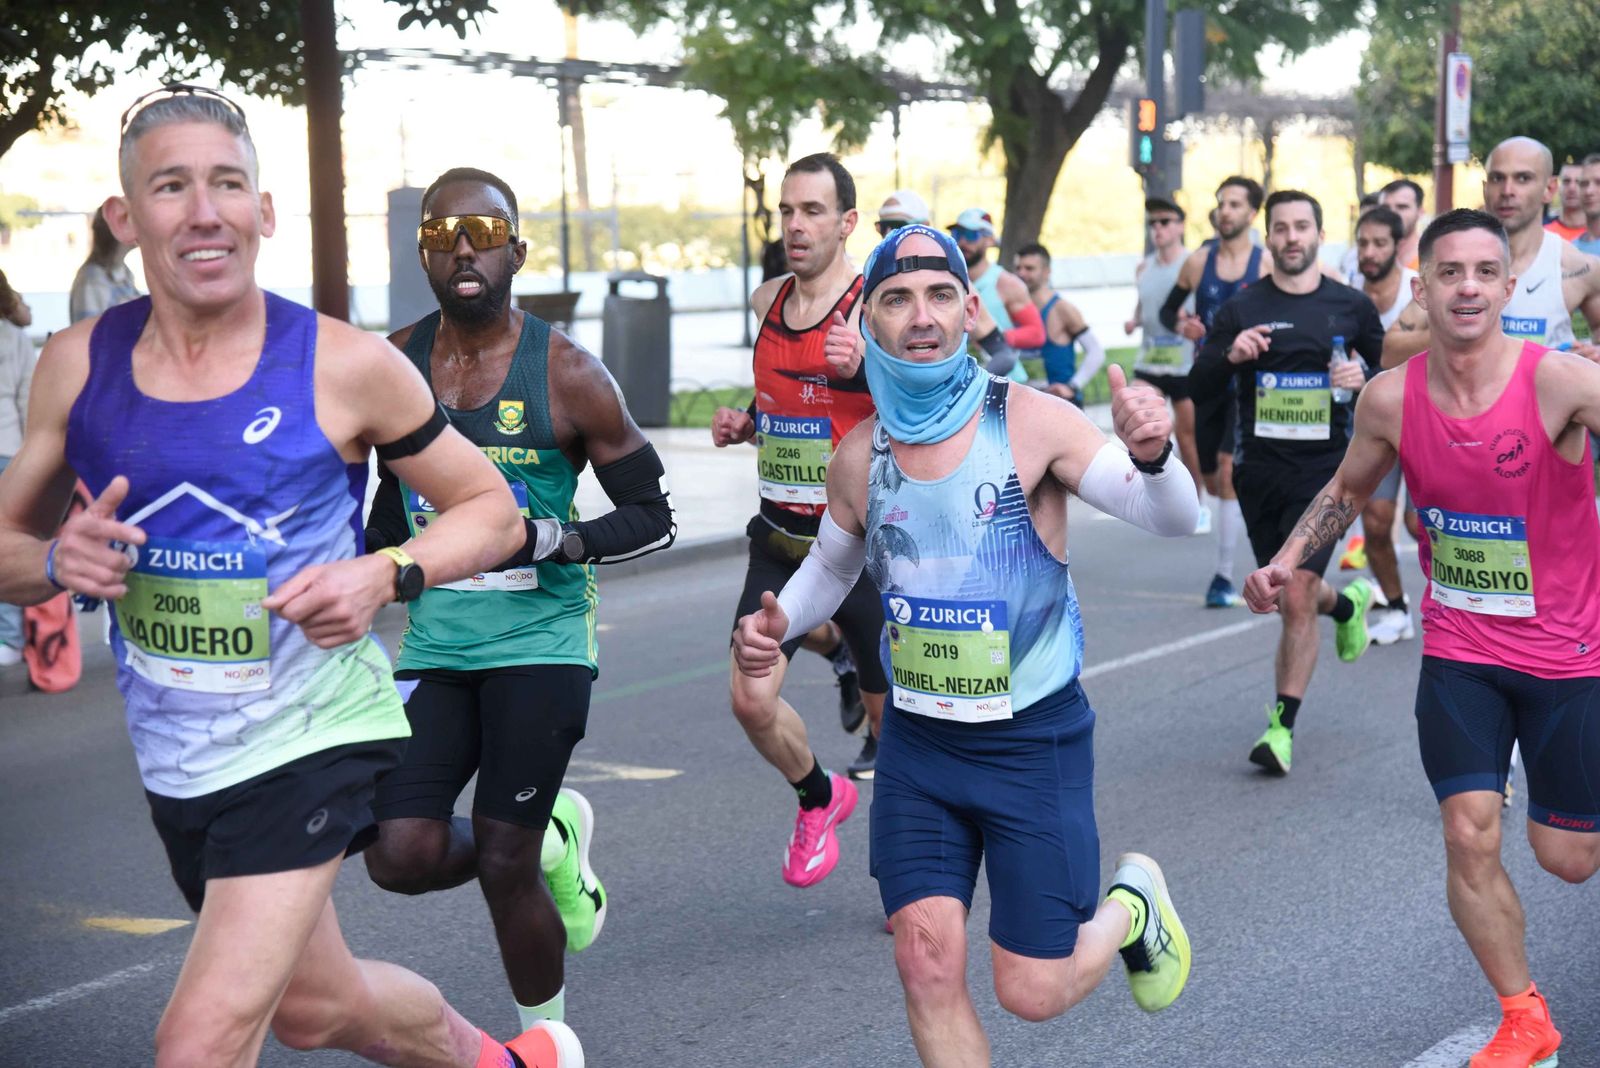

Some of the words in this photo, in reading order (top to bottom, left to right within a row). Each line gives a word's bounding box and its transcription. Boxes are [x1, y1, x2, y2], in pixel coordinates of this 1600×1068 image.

[1502, 319, 1538, 332] URICH
[1281, 376, 1323, 387] ZURICH
[1259, 408, 1326, 423] HENRIQUE
[773, 421, 820, 434] ZURICH
[479, 446, 541, 465] RICA
[776, 447, 801, 459] 2246
[761, 460, 827, 483] CASTILLO
[1448, 518, 1512, 535] ZURICH
[148, 548, 244, 571] ZURICH
[1453, 547, 1486, 564] 3088
[1433, 558, 1529, 591] TOMASIYO
[153, 593, 201, 615] 2008
[919, 606, 991, 624] ZURICH
[123, 611, 253, 656] VAQUERO
[923, 642, 959, 660] 2019
[892, 665, 1009, 695] YURIEL-NEIZAN
